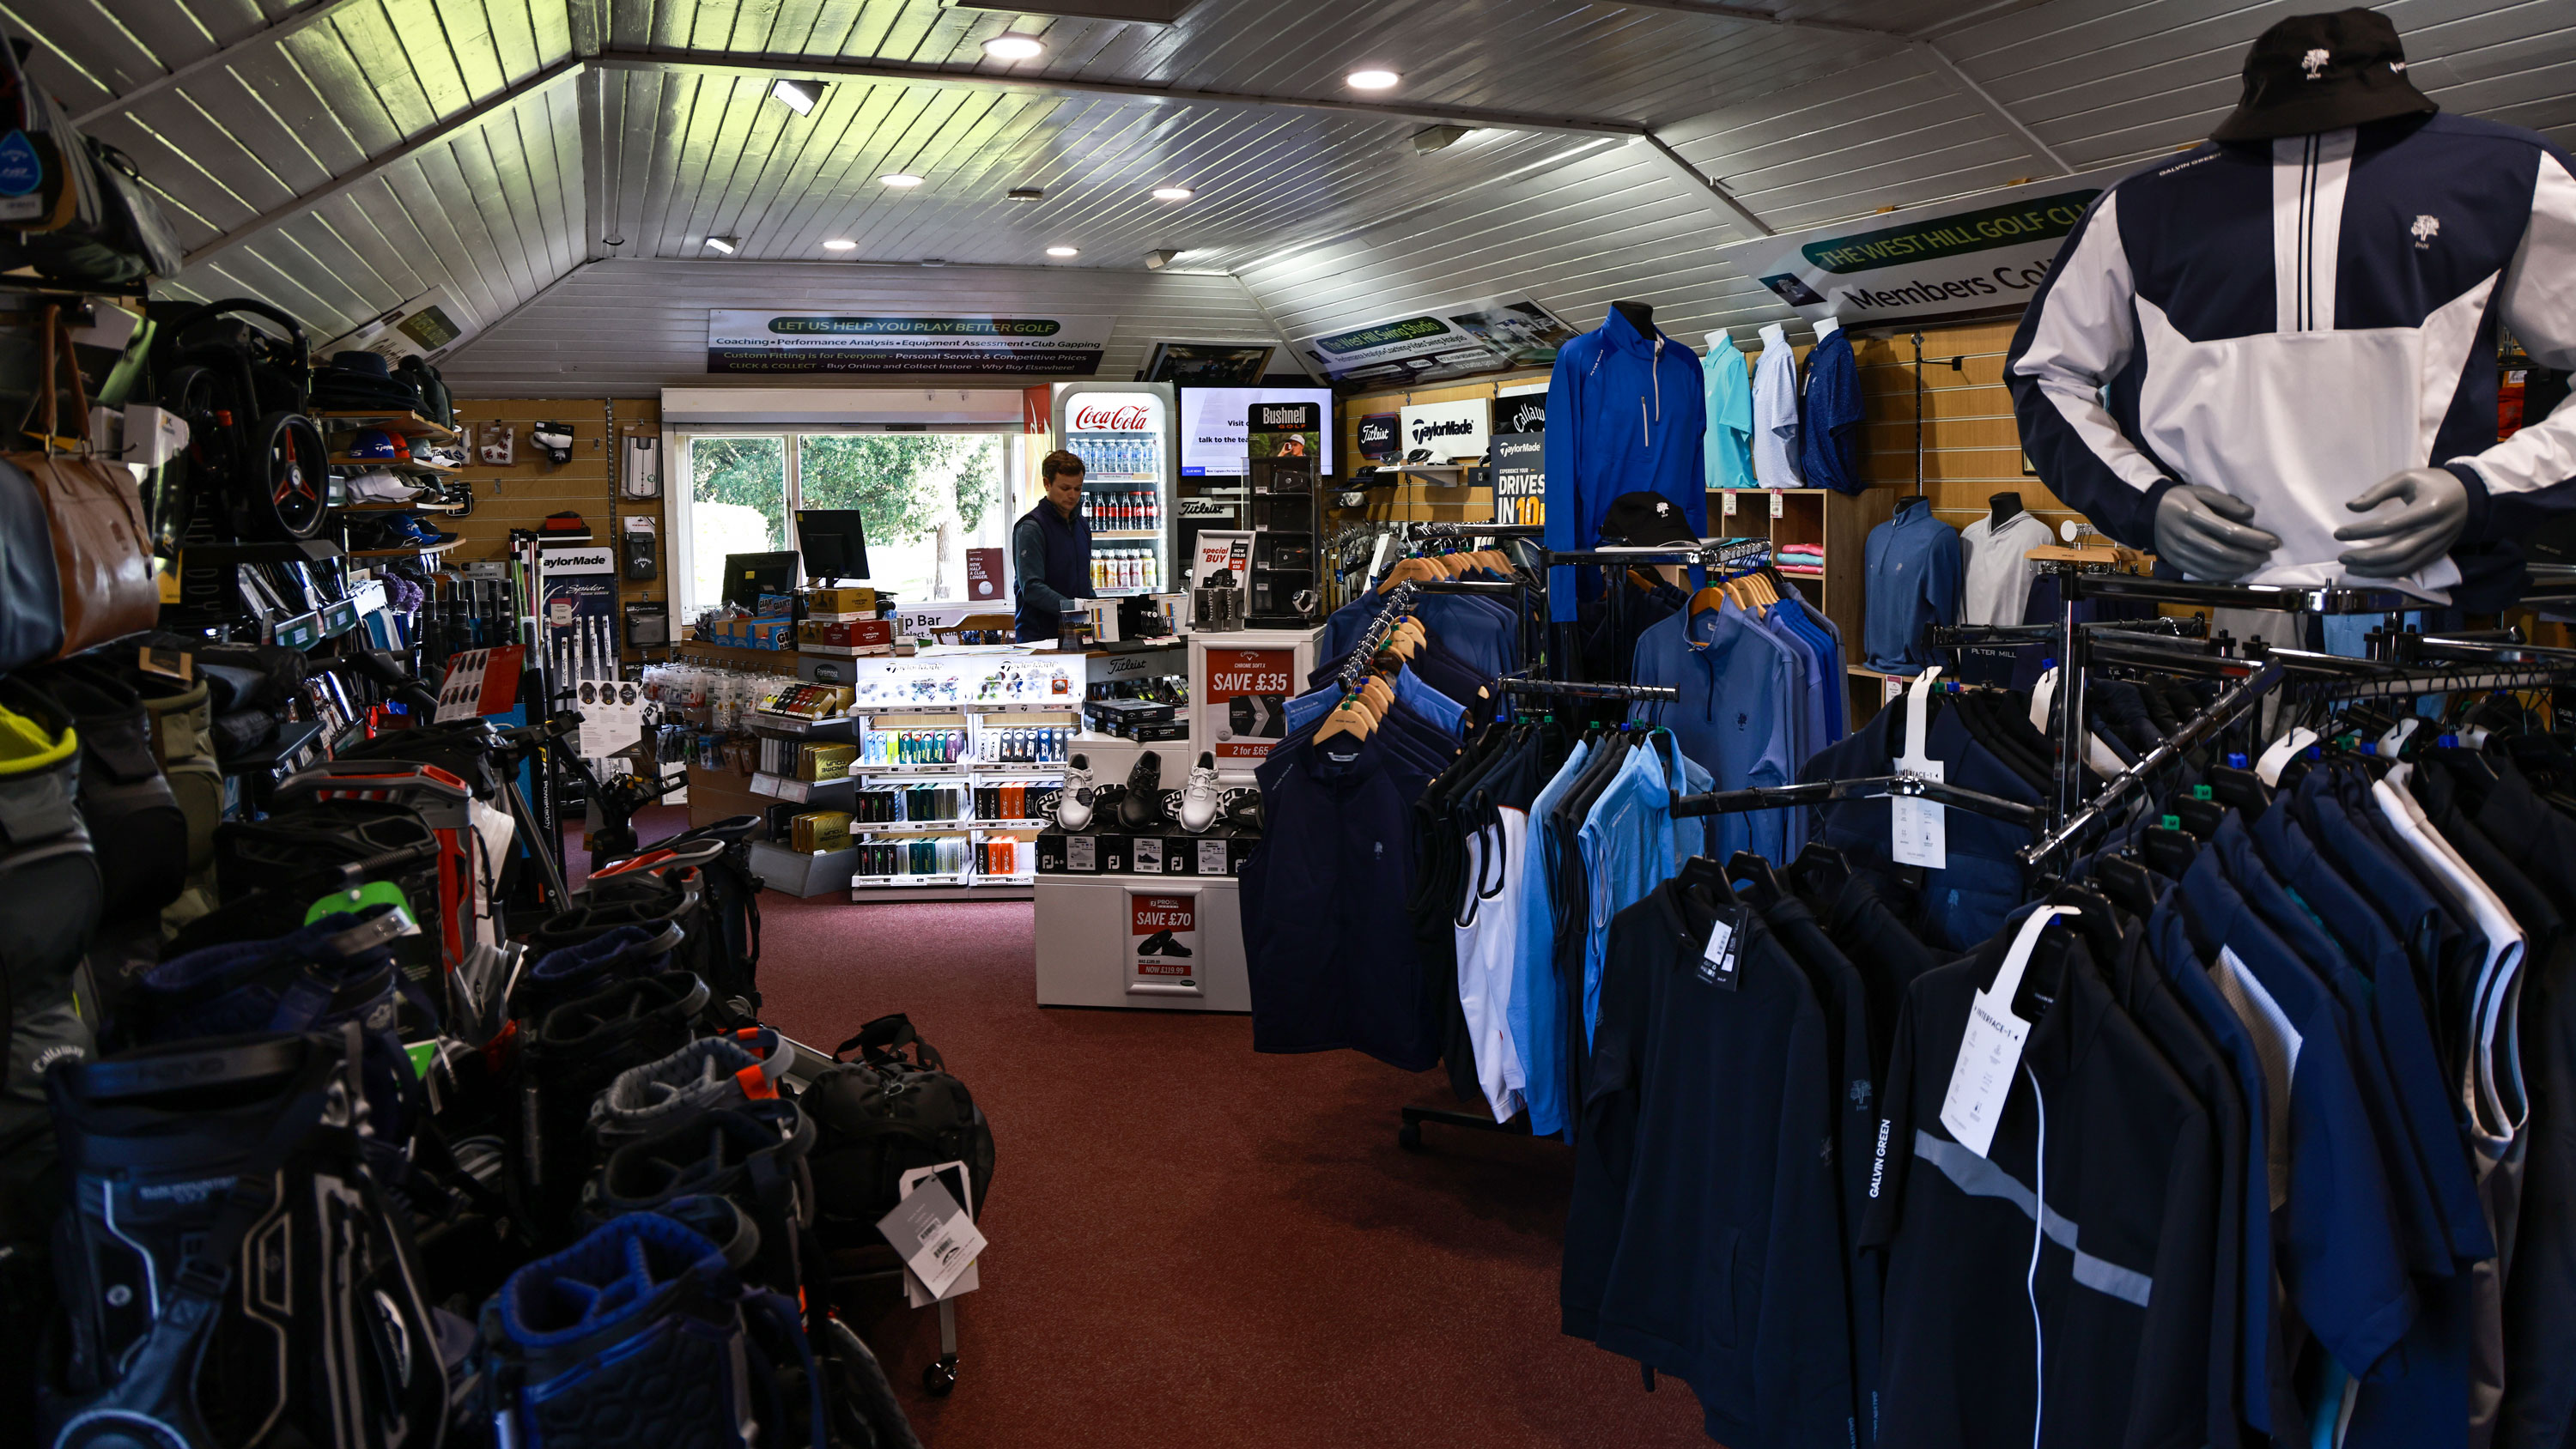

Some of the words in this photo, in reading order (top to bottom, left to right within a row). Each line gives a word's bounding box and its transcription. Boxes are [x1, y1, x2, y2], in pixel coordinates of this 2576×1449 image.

[2159, 162, 2190, 176] GALVIN
[1815, 246, 1867, 267] THE
[1859, 233, 1927, 259] WEST
[1923, 225, 1981, 248] HILL
[1977, 211, 2045, 239] GOLF
[1843, 276, 1996, 310] Members
[1993, 258, 2052, 289] Col
[777, 321, 805, 330] LET
[808, 322, 829, 330] US
[834, 322, 872, 330] HELP
[877, 322, 910, 331] YOU
[914, 323, 952, 331] PLAY
[955, 323, 1010, 332] BETTER
[1014, 324, 1054, 333] GOLF
[1326, 341, 1343, 351] The
[1340, 335, 1364, 348] West
[1362, 330, 1380, 345] Hill
[1376, 323, 1413, 342] Swing
[1406, 320, 1441, 336] Studio
[716, 337, 769, 347] Coaching
[849, 338, 894, 347] Analysis
[902, 339, 960, 348] Equipment
[1057, 341, 1101, 349] Gapping
[1076, 405, 1151, 429] Coca-Cola
[1263, 407, 1307, 424] Bushnell
[1361, 424, 1388, 443] Titleist
[1412, 419, 1473, 445] TaylorMade
[1500, 442, 1540, 458] TaylorMade
[1498, 474, 1546, 495] DRIVES
[1178, 501, 1224, 515] Titleist
[1498, 497, 1515, 524] IN
[544, 555, 606, 568] aylorMade
[1206, 555, 1226, 563] BUY
[566, 584, 605, 595] Spider
[759, 597, 773, 609] GIAN
[917, 615, 941, 626] Bar
[1971, 647, 1996, 656] PETER
[817, 668, 838, 678] Foremost
[886, 661, 944, 673] TaylorMade
[1108, 658, 1147, 674] Titleist
[1213, 673, 1253, 691] SAVE
[1255, 673, 1287, 691] £35
[1233, 746, 1238, 755] 2
[1240, 745, 1251, 755] for
[1252, 746, 1269, 755] £65
[1042, 855, 1054, 869] FJ
[1108, 855, 1120, 870] FJ
[1170, 856, 1183, 870] FJ
[1137, 912, 1166, 925] SAVE
[1168, 912, 1191, 926] £70
[1876, 1119, 1891, 1157] GREEN
[1869, 1157, 1884, 1198] GALVIN
